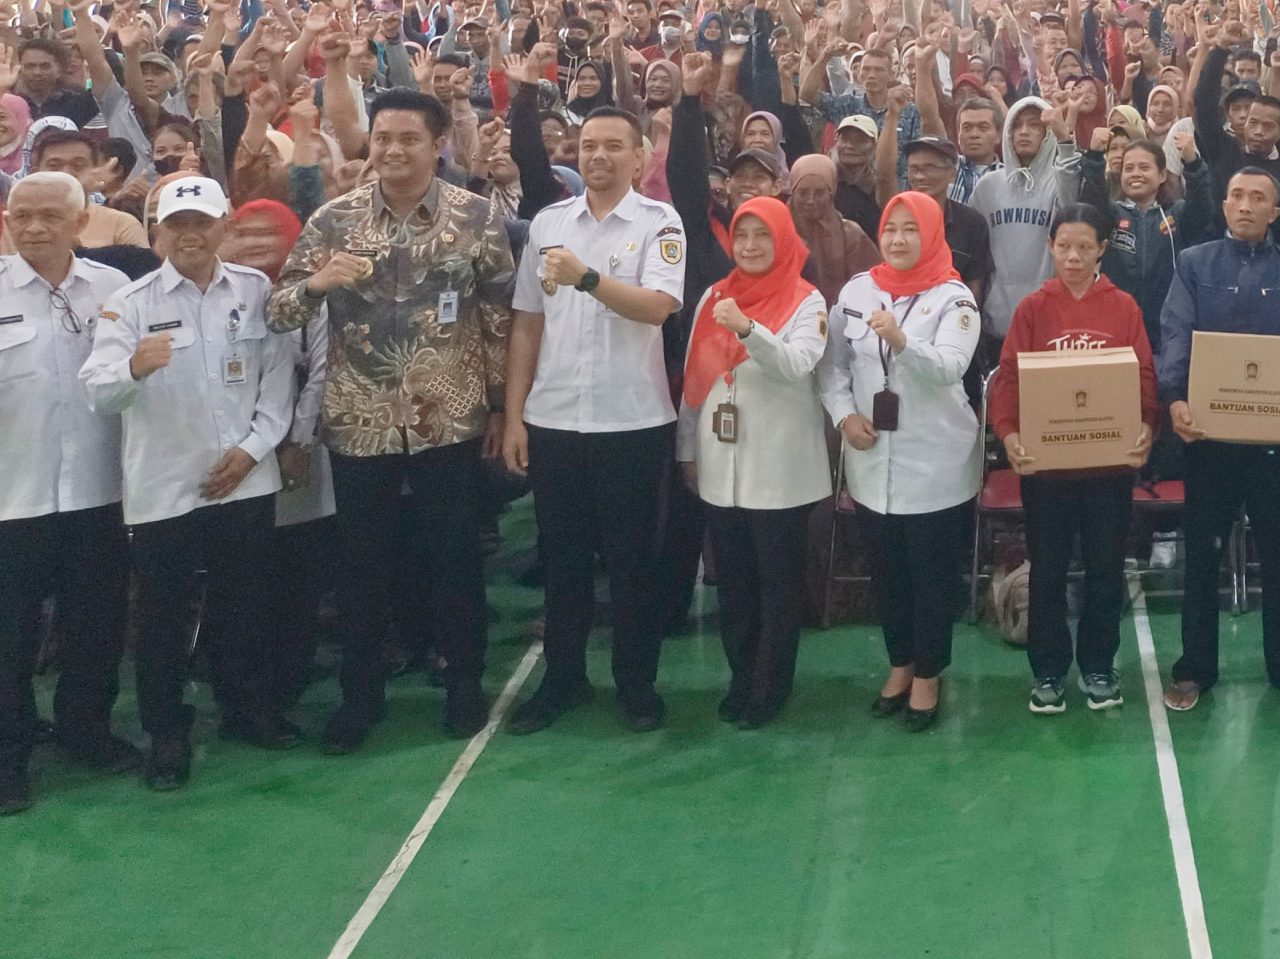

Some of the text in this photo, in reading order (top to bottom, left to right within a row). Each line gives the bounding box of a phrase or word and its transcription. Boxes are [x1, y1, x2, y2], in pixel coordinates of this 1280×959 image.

[1209, 402, 1255, 413] BANTUAN
[1041, 431, 1122, 443] BANTUAN SOSIAL
